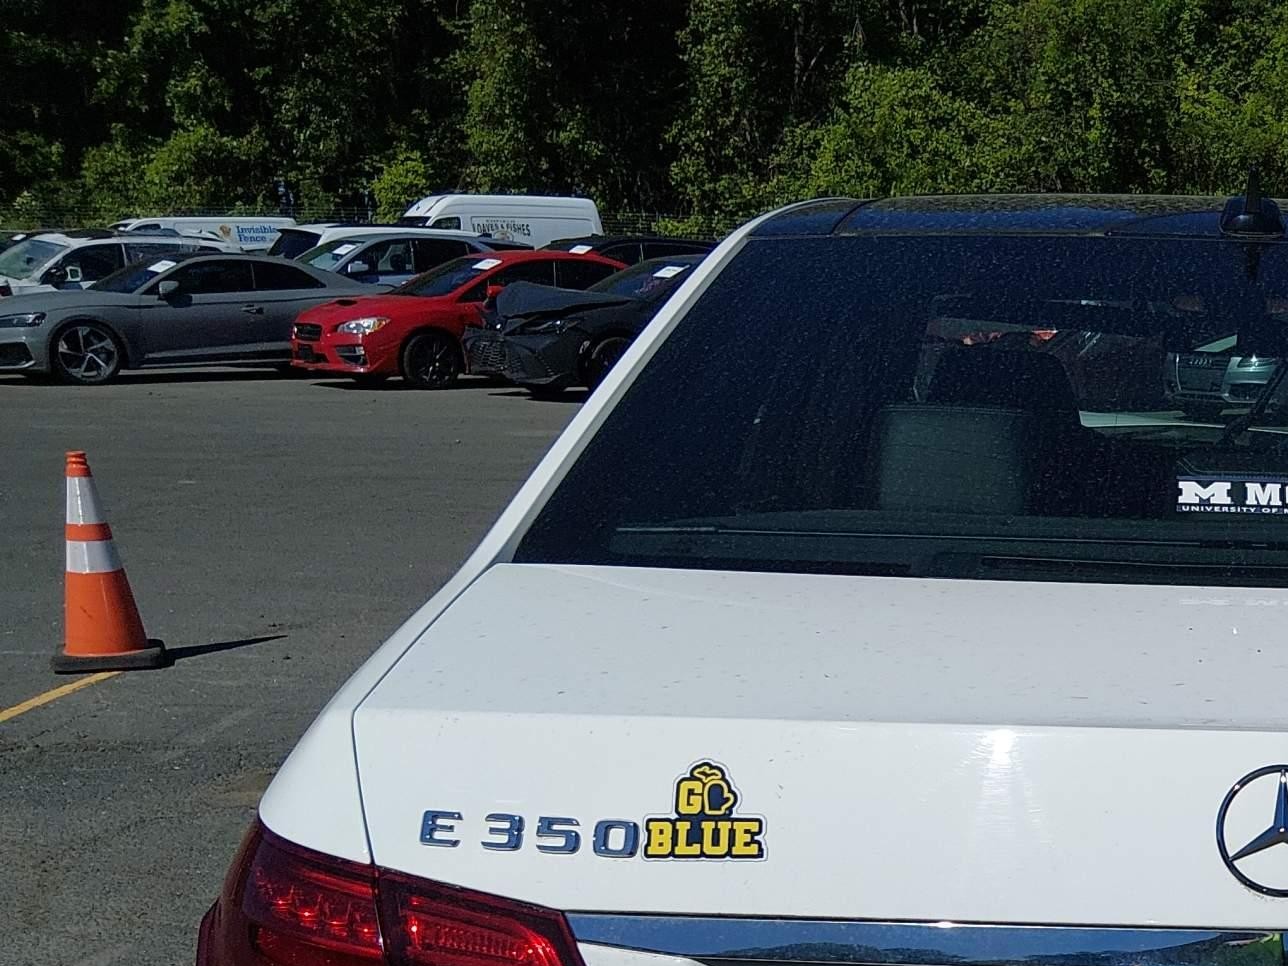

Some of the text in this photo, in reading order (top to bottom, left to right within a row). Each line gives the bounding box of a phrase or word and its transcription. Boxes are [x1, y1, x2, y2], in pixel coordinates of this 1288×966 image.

[236, 225, 277, 234] Invisible
[239, 234, 267, 242] Fence
[1178, 481, 1232, 504] M
[1181, 505, 1257, 513] UNIVERSITY
[419, 809, 641, 859] E 350
[646, 820, 761, 856] BLUE
